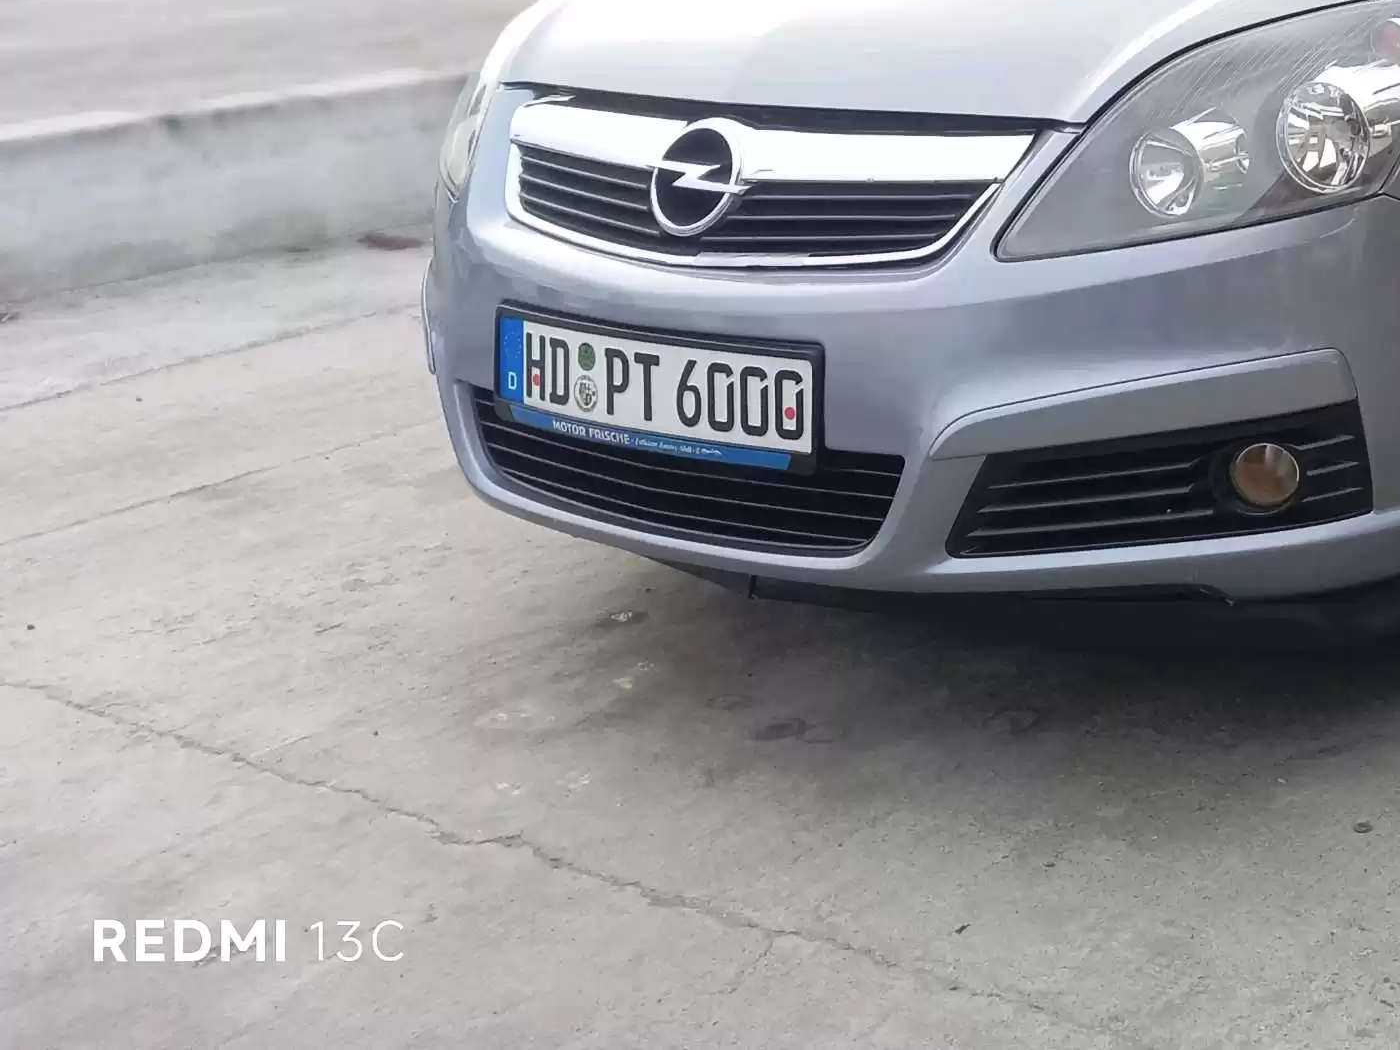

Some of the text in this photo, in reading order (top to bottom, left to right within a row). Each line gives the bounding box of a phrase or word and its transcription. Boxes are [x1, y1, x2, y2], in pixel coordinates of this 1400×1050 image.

[508, 371, 518, 391] D
[525, 331, 570, 406] HD
[604, 347, 660, 422] PT
[676, 359, 805, 441] 6000
[552, 420, 587, 438] MOTOR
